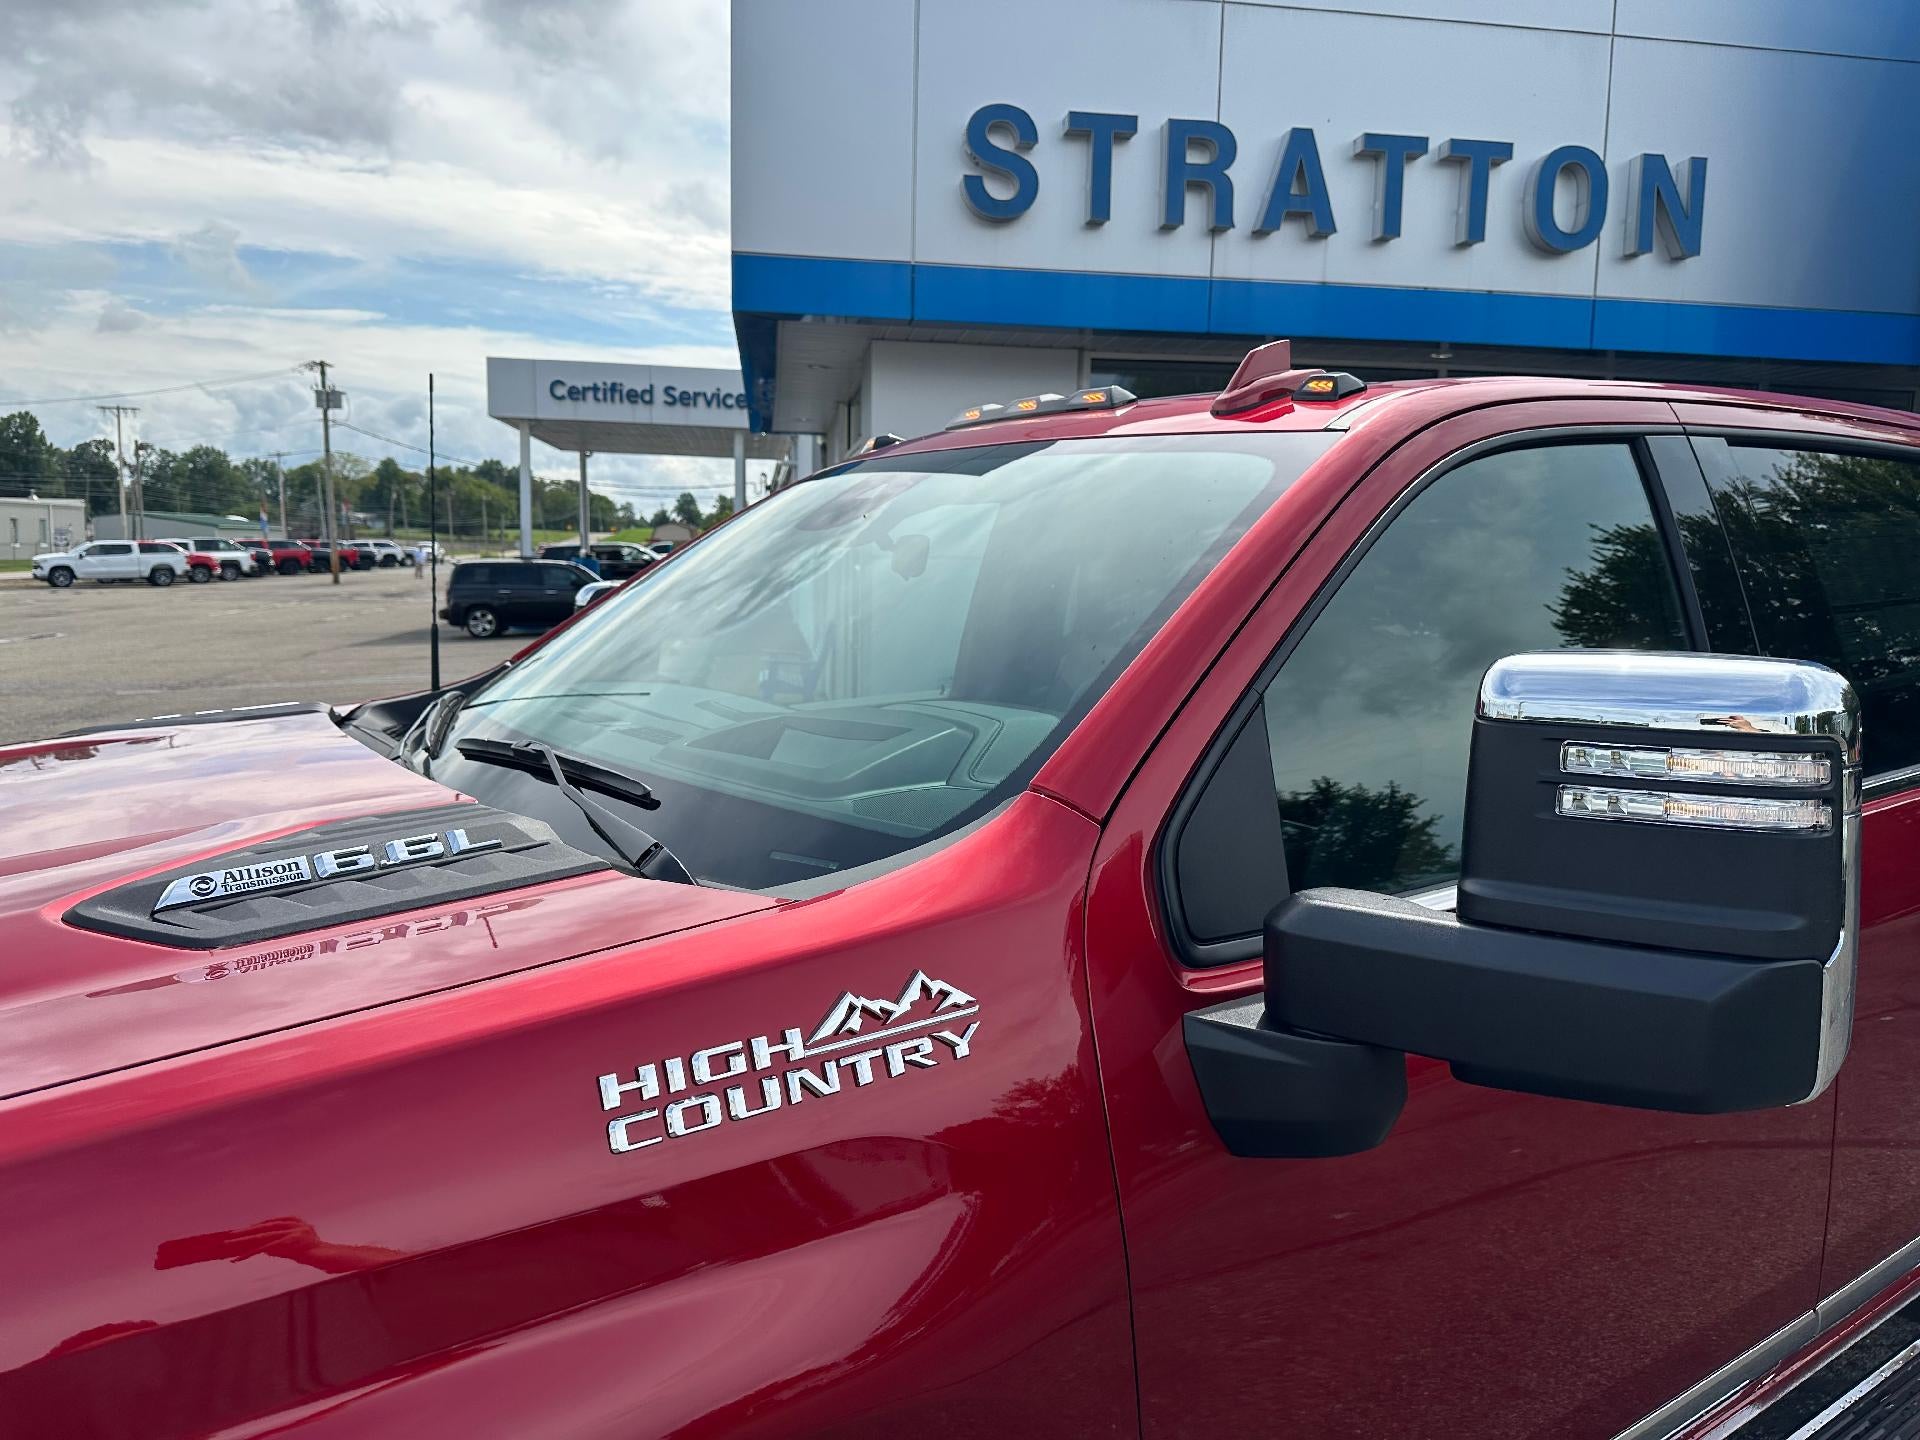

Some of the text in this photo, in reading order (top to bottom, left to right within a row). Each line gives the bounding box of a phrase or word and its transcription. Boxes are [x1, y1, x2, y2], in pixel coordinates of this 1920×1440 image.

[962, 103, 1708, 261] STRATTON
[550, 379, 747, 410] Certified Service
[222, 861, 303, 884] Allison
[313, 828, 503, 879] 6.6L
[221, 871, 305, 893] Transmission
[598, 1027, 806, 1111] HIGH
[607, 1021, 981, 1154] COUNTRY
